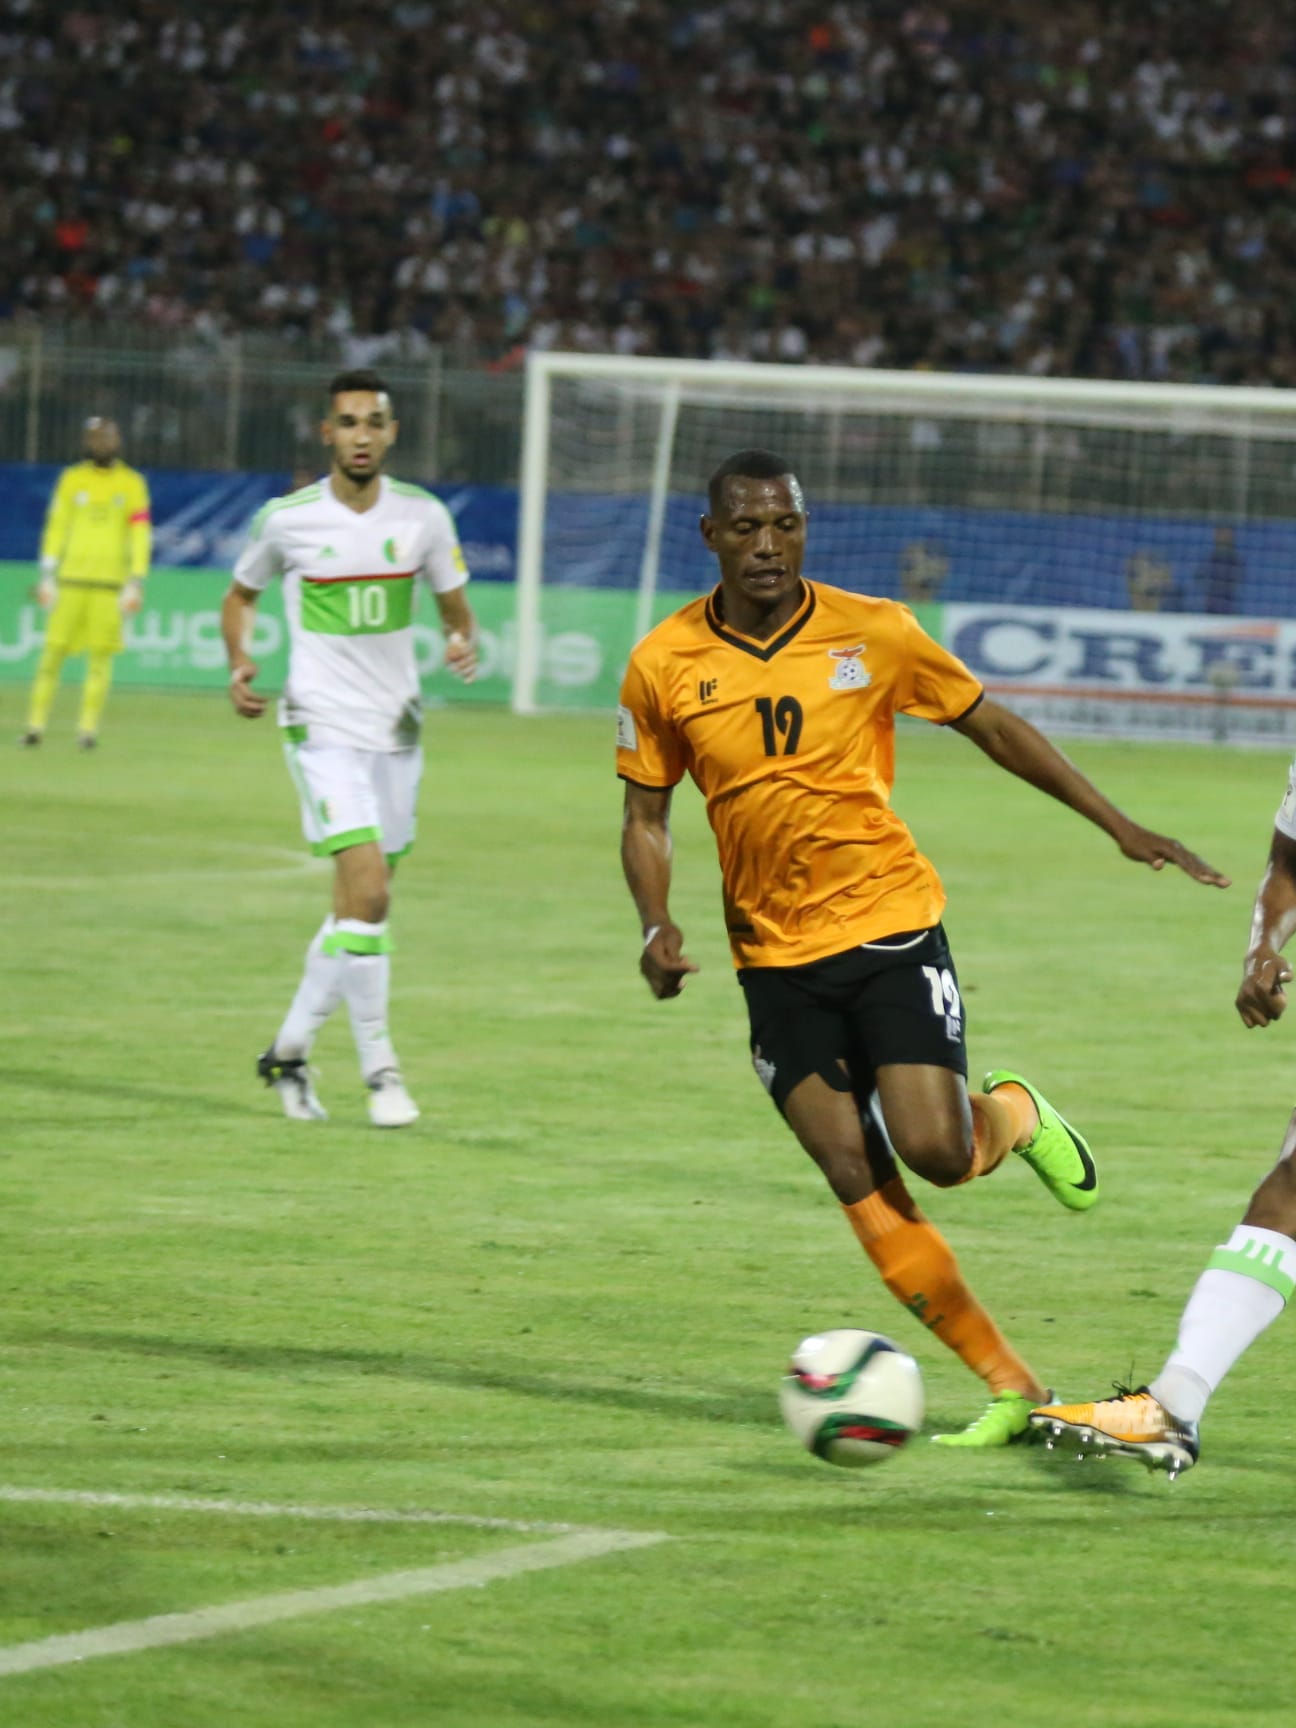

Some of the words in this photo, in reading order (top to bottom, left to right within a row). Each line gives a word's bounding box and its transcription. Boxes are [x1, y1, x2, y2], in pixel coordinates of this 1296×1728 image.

[347, 585, 388, 629] 10
[755, 695, 804, 757] 19
[922, 965, 961, 1019] 19
